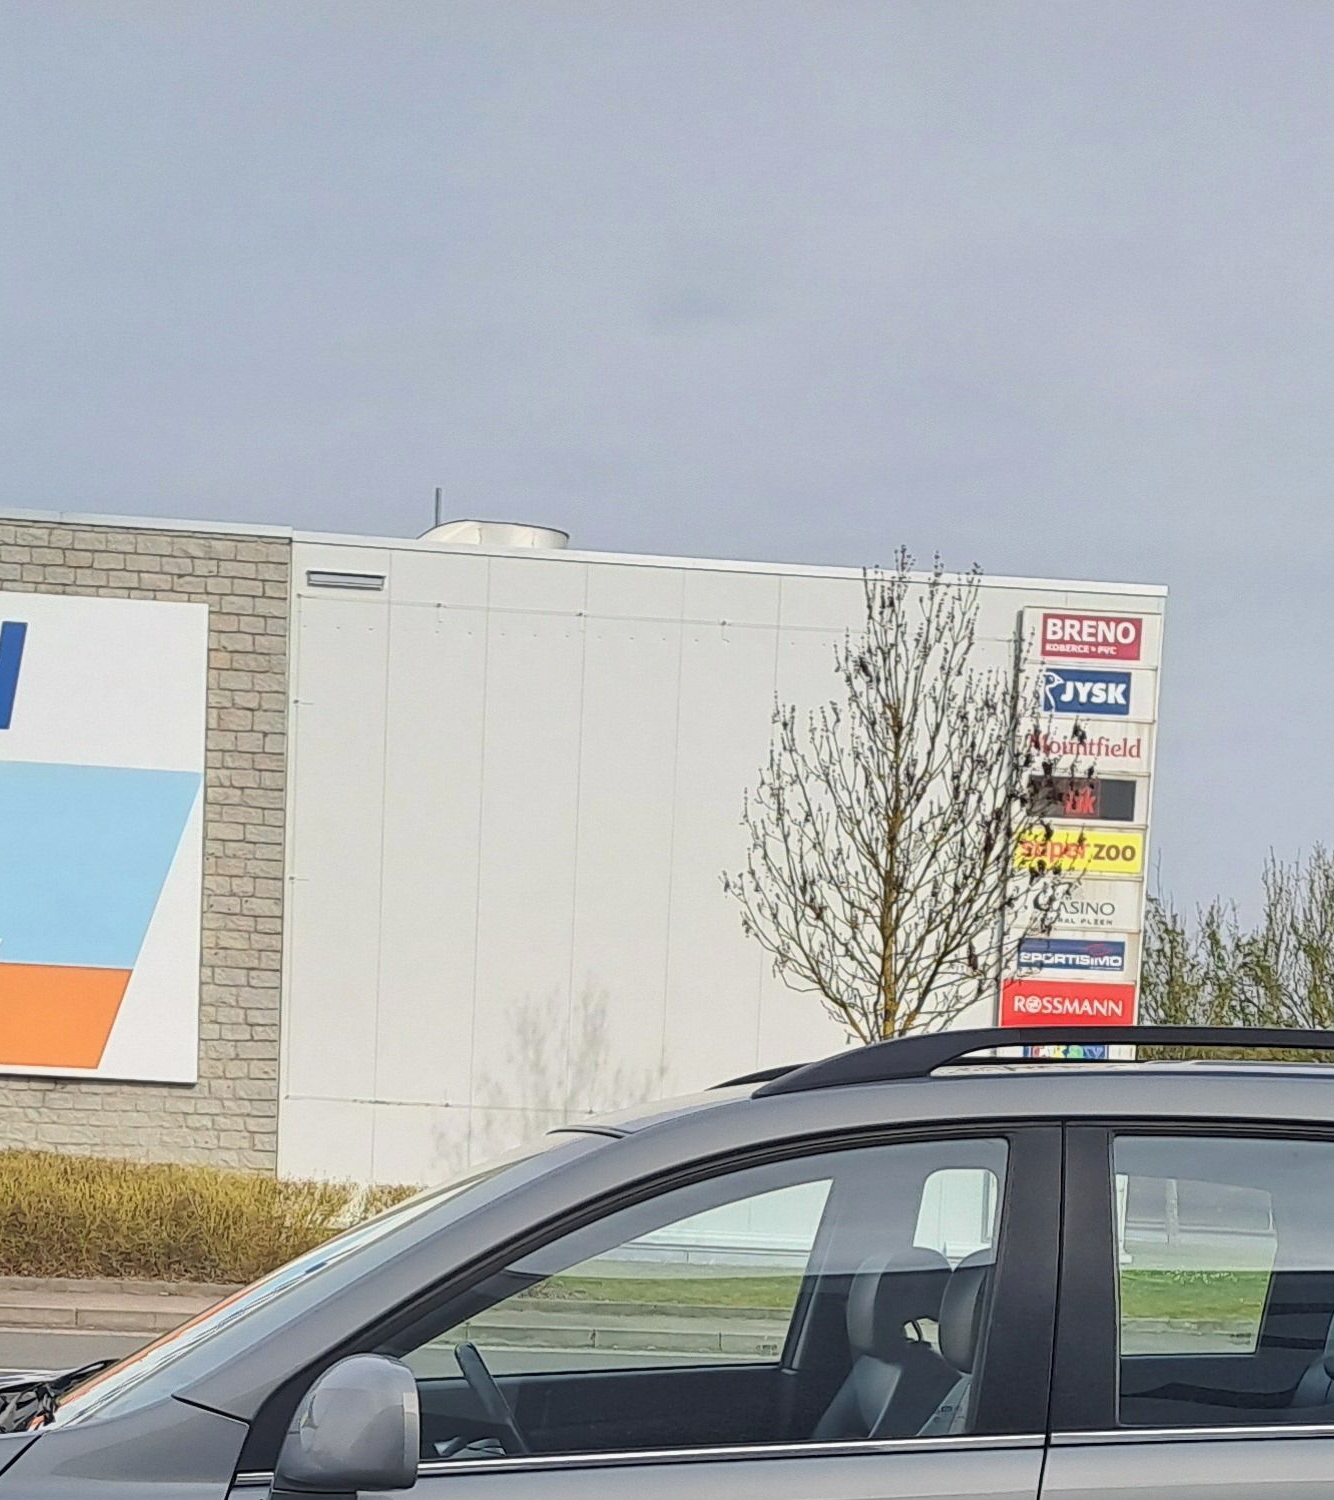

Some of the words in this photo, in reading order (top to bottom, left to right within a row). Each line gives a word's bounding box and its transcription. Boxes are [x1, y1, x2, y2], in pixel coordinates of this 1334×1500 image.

[1047, 619, 1136, 644] BRENO
[1060, 681, 1127, 705] JYSK
[1092, 844, 1136, 861] zoo
[1019, 951, 1123, 967] SPORTISIMO
[1013, 995, 1123, 1017] ROSSMANN
